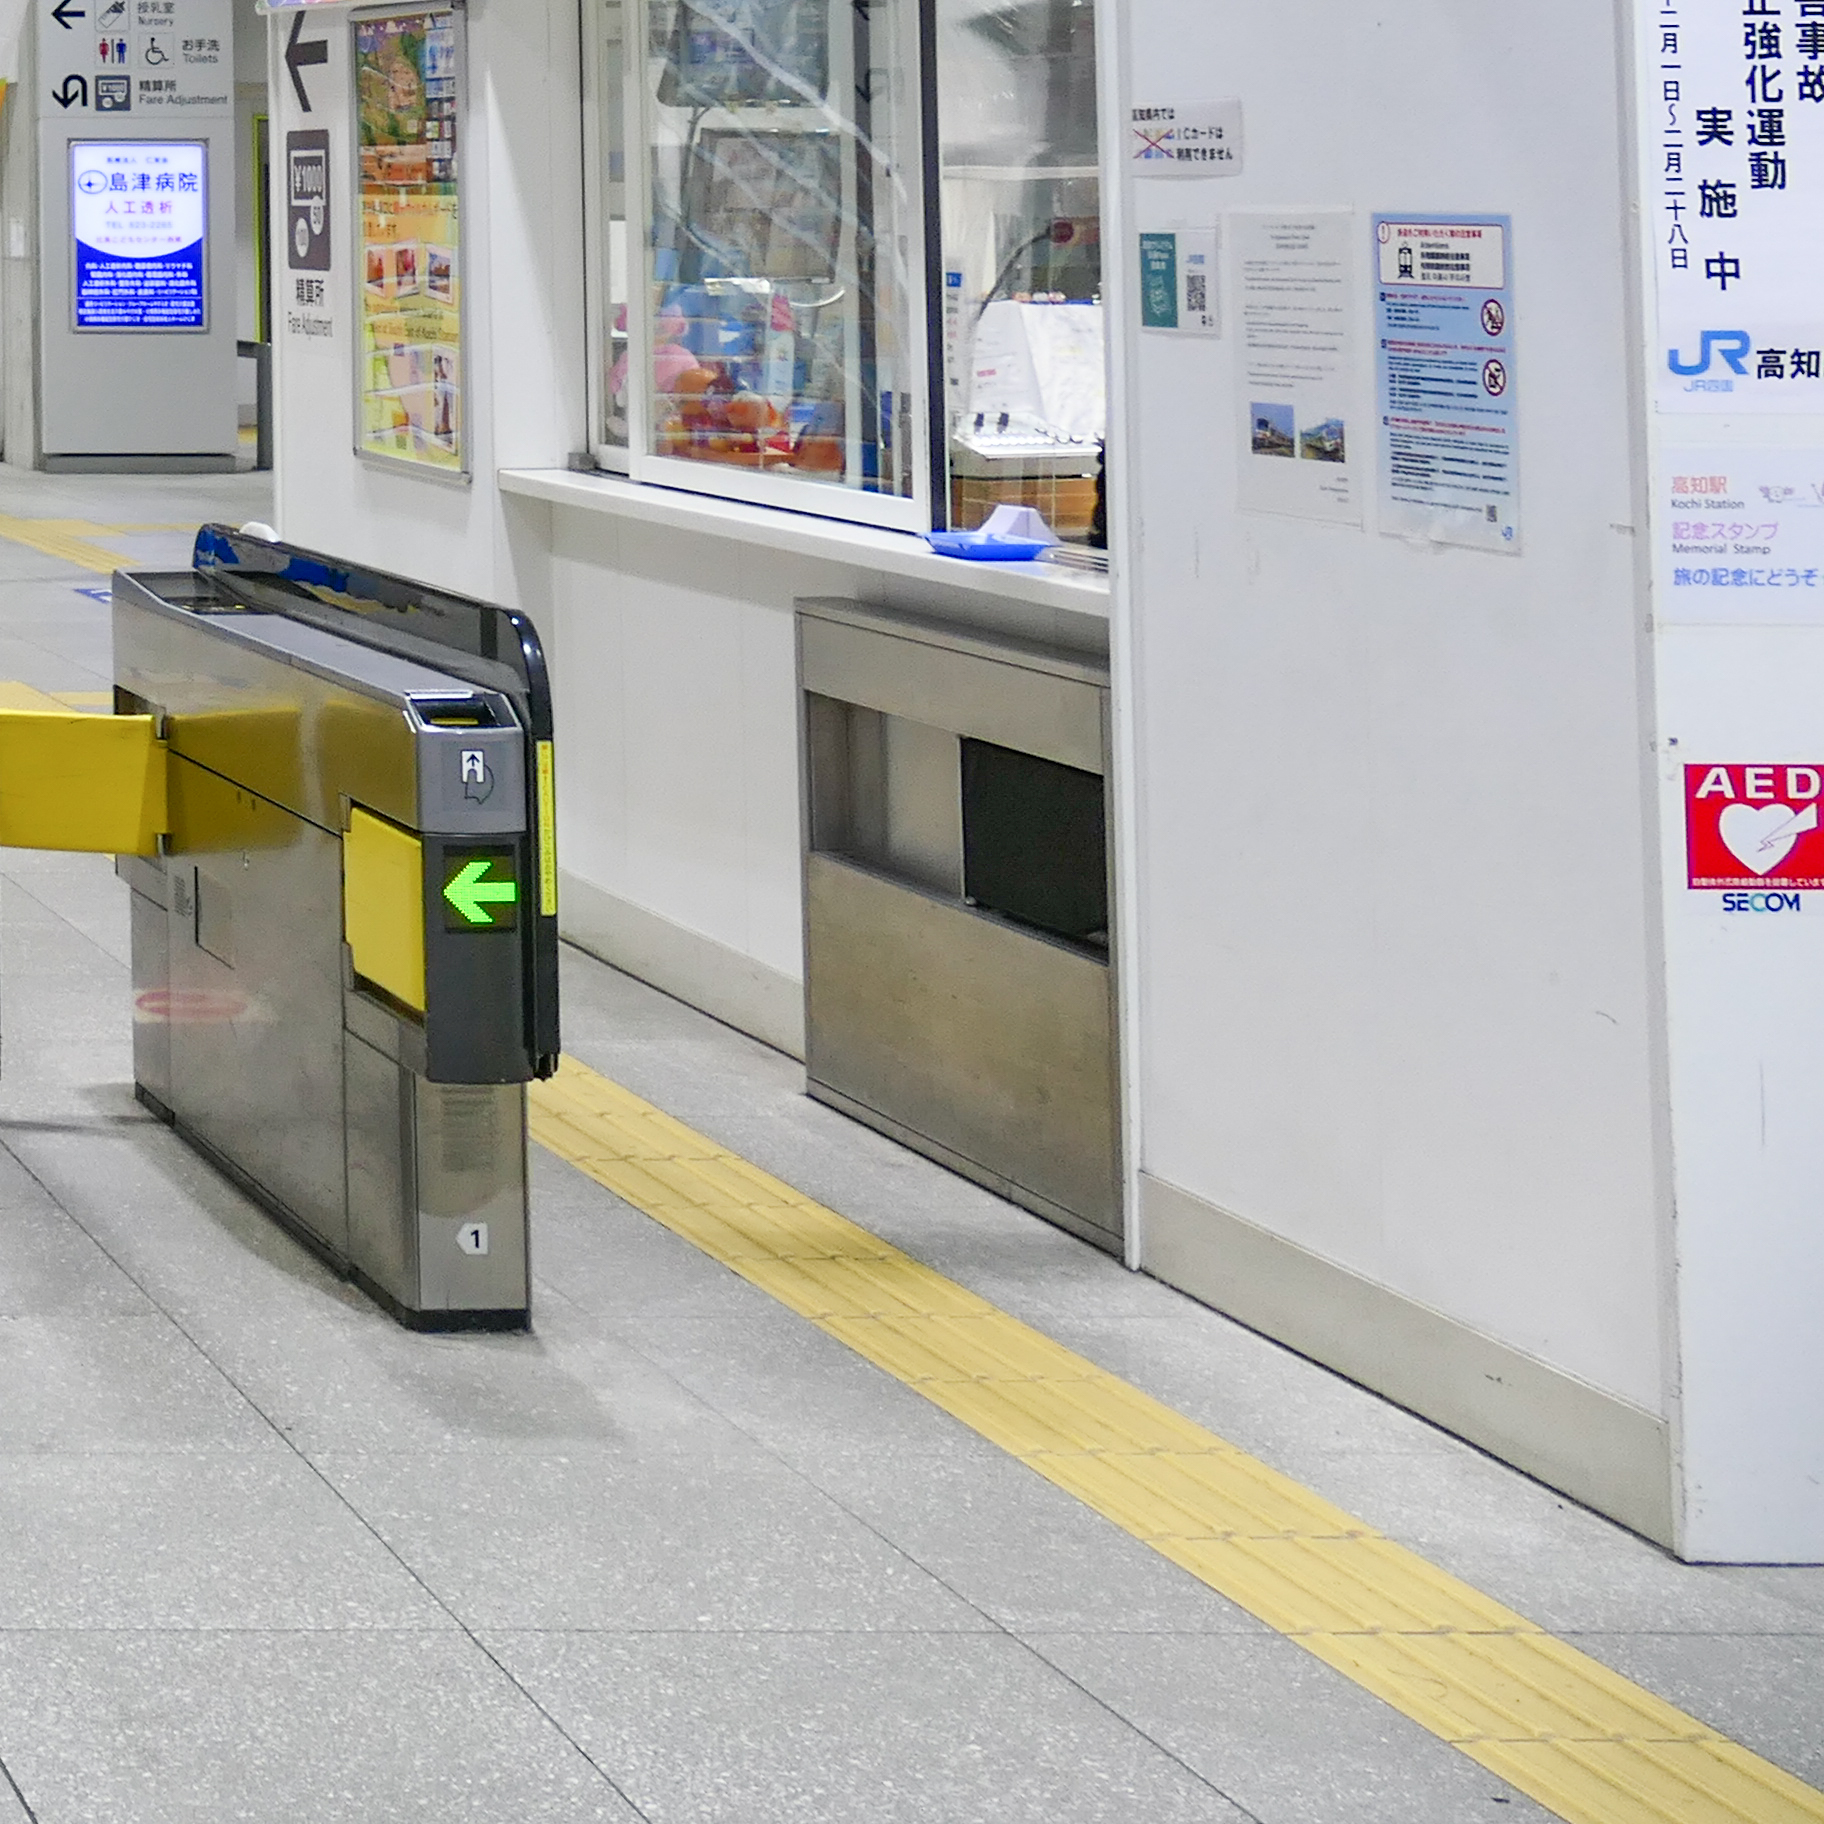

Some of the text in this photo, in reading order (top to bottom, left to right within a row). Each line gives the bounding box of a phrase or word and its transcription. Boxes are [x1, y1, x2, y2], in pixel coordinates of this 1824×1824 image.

[137, 2, 175, 14] 授乳室
[138, 16, 173, 26] Nursery
[182, 39, 220, 51] お手洗
[183, 53, 218, 63] Toilets
[139, 80, 177, 92] 精算所
[139, 94, 227, 105] Fare Adjustment
[109, 172, 198, 192] 島津病院
[1695, 107, 1742, 291] 実施中
[105, 201, 172, 214] 人工透析
[1668, 330, 1824, 380] JR 高知
[1672, 476, 1727, 494] 高知駅
[1672, 499, 1745, 510] Kochi Station
[1672, 521, 1779, 540] 記念スタンプ
[1672, 543, 1771, 555] Memorial Stamp
[1695, 767, 1821, 799] AED
[1722, 893, 1800, 912] SECOM
[470, 1230, 481, 1249] 1
